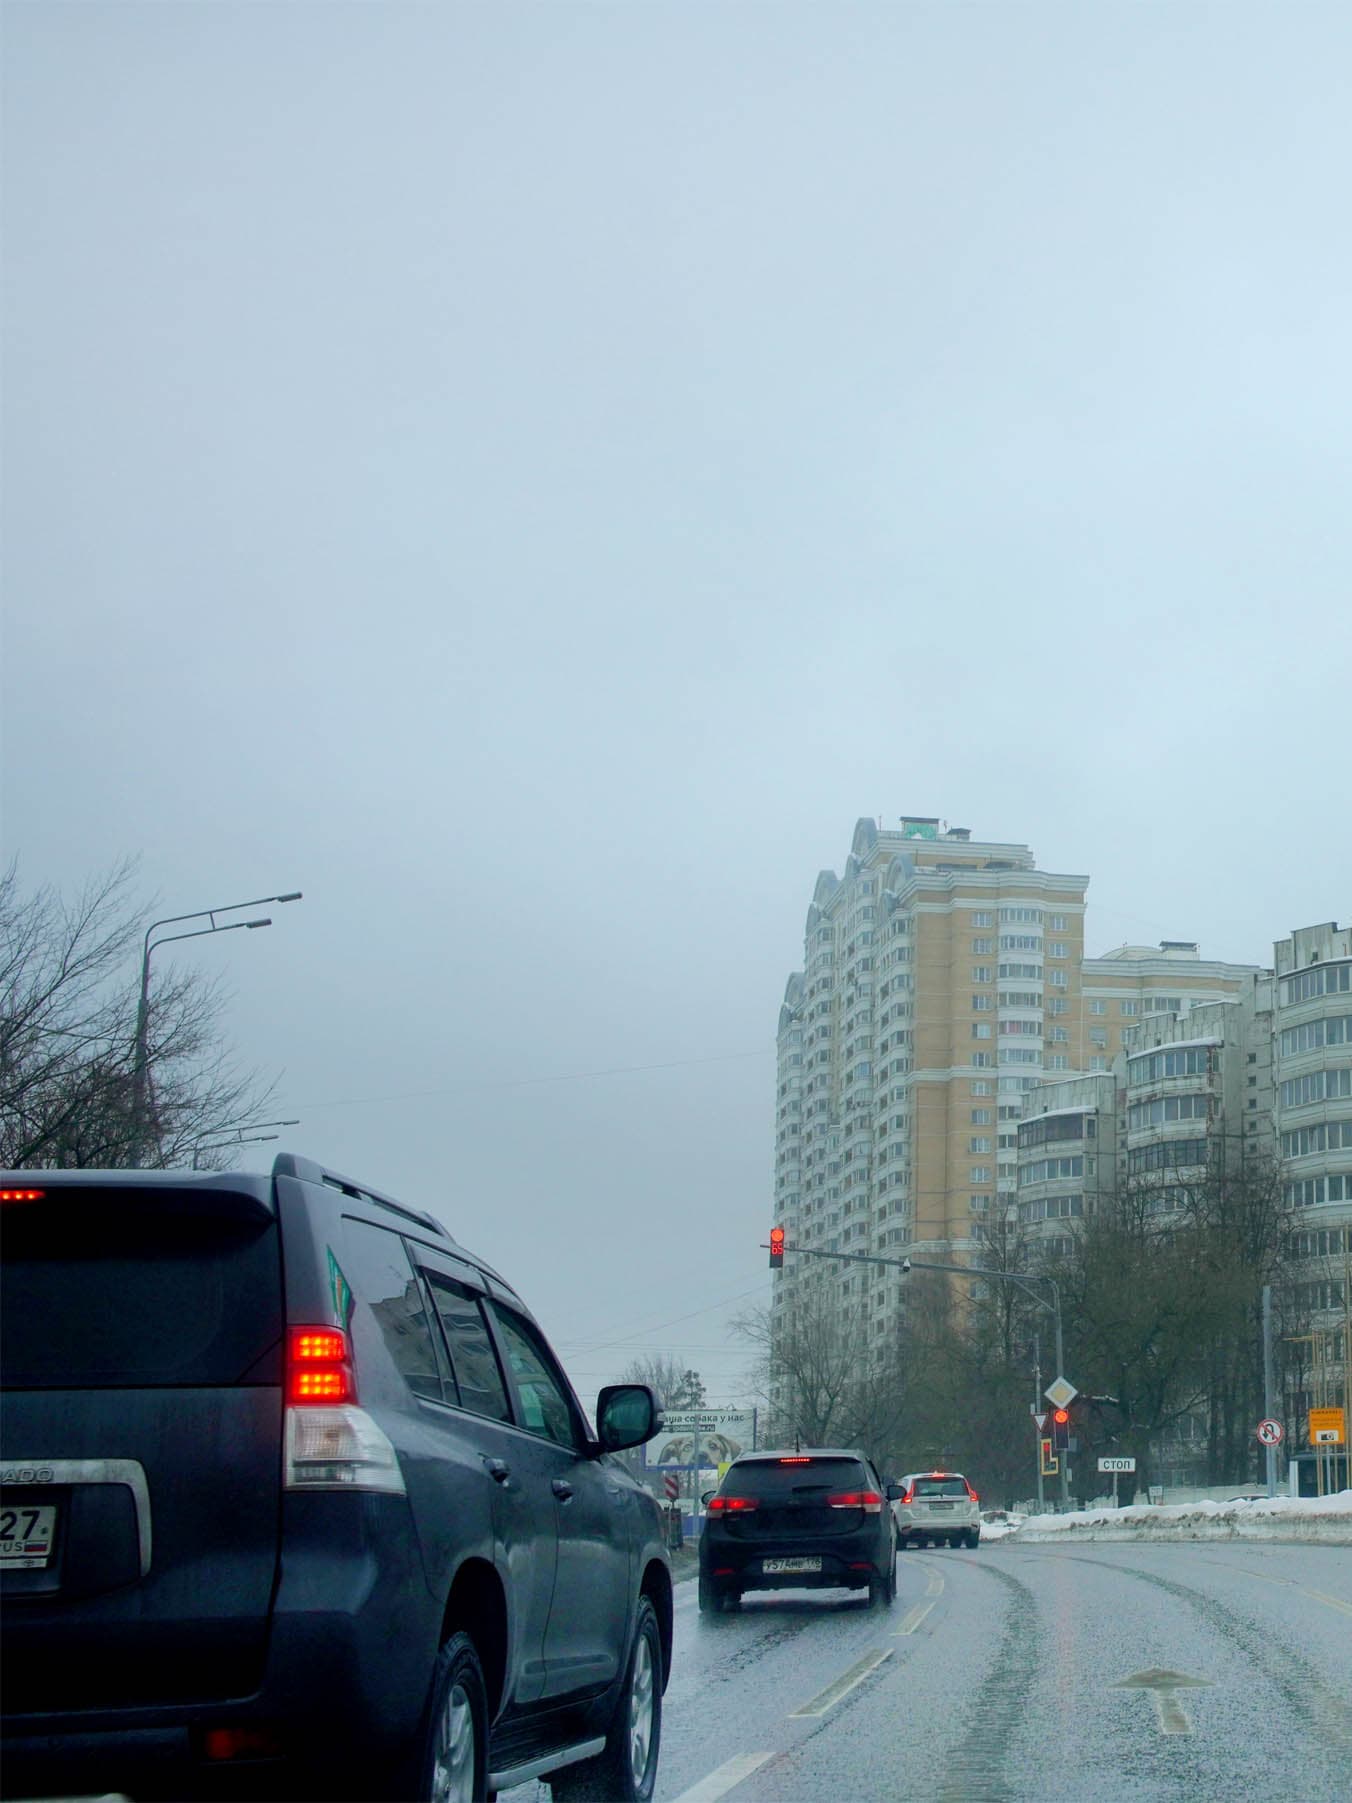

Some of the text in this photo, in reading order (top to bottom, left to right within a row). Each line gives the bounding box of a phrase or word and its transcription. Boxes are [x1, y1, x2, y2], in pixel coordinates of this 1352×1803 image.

[727, 1413, 745, 1422] нас
[1103, 1460, 1130, 1470] СТОП
[0, 1467, 54, 1483] ADO
[0, 1542, 23, 1552] US
